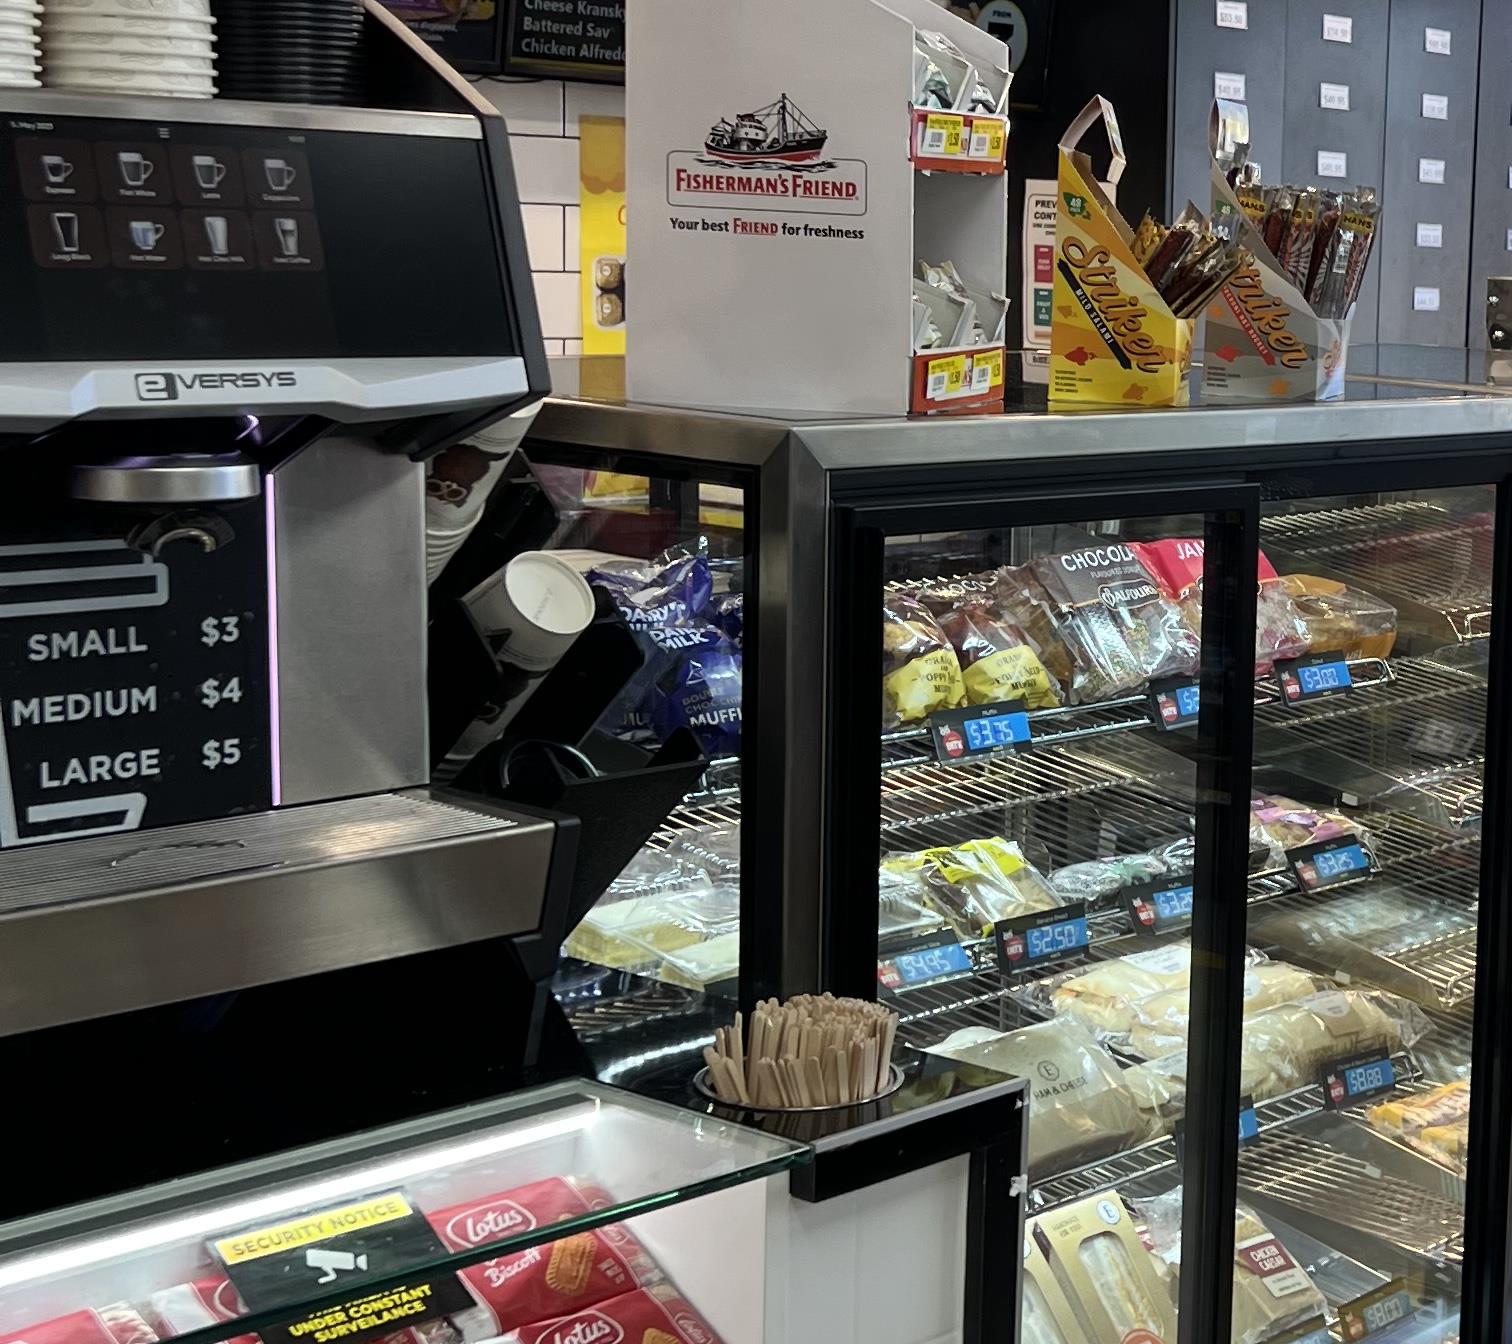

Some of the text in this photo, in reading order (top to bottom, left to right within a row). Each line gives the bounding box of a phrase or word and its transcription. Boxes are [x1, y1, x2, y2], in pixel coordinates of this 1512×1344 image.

[523, 16, 610, 39] Battered Sav
[521, 38, 576, 57] Chicken
[676, 168, 857, 198] FISHERMAN'S FRIEND
[670, 217, 864, 240] Your best FRIEND for freshness
[1090, 310, 1114, 345] SALAMI
[27, 616, 240, 662] SMALL $3
[12, 676, 242, 727] MEDIUM $4
[690, 707, 743, 727] MUFFI
[970, 719, 1013, 746] $3.75
[40, 738, 241, 789] LARGE $5
[1031, 925, 1076, 953] $2.50
[1034, 1087, 1053, 1101] HAM
[231, 1201, 401, 1256] SECURITY NOTICE
[466, 1208, 523, 1243] Lotus
[483, 1246, 542, 1288] Biscoff
[288, 1309, 350, 1337] UNDER
[349, 1283, 433, 1318] CONSTANT
